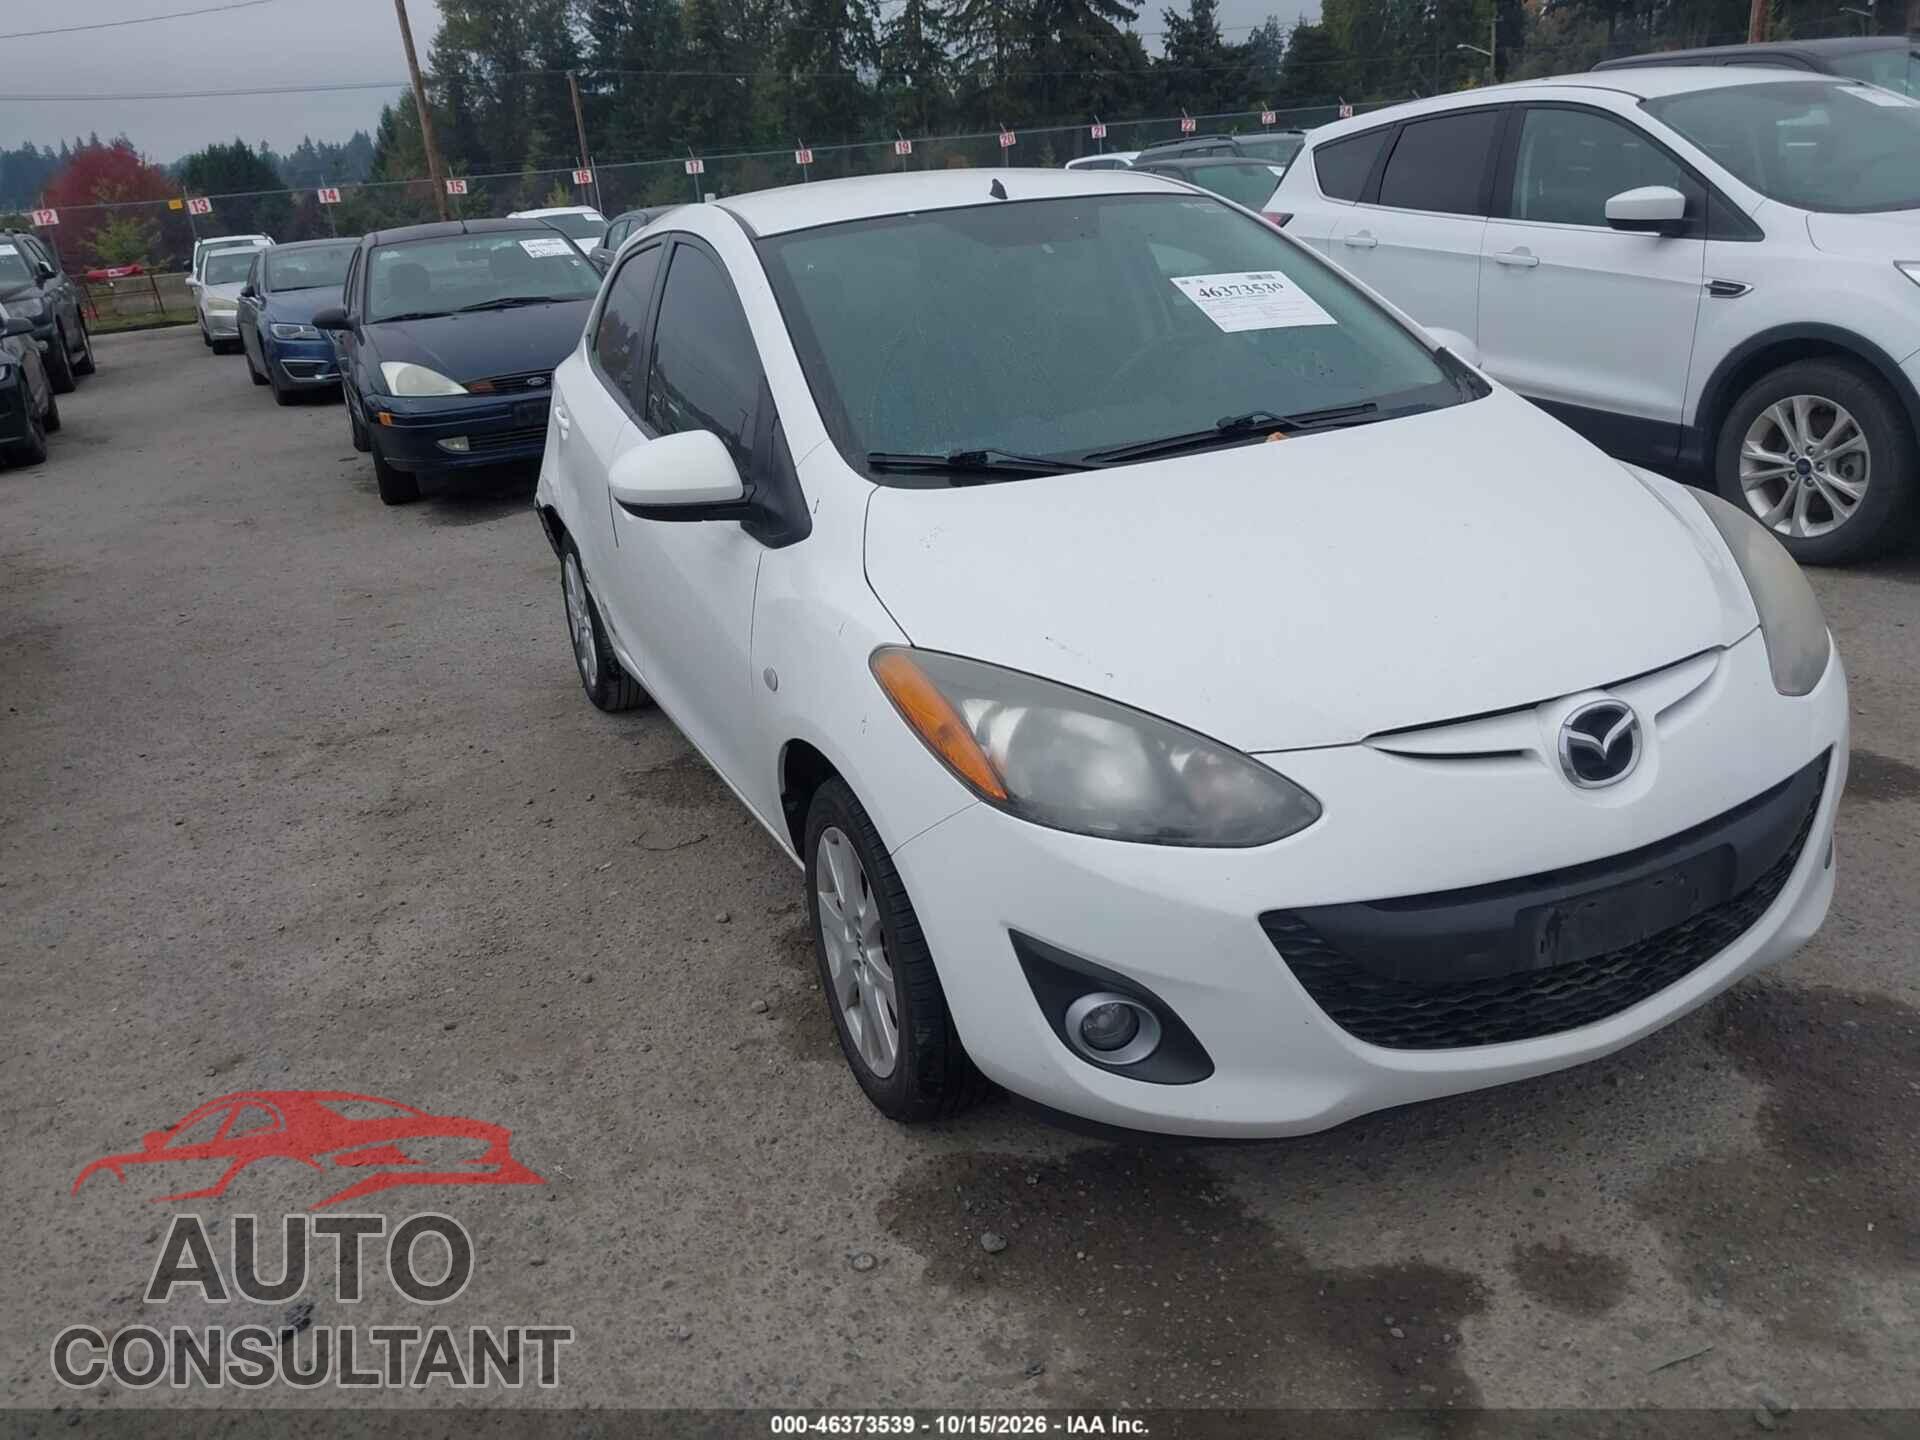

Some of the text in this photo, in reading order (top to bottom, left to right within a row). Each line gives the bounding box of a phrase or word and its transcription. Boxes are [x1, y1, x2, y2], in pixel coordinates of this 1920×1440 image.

[1094, 126, 1106, 138] 21
[898, 141, 910, 154] 19
[688, 160, 700, 173] 17
[576, 170, 590, 183] 16
[450, 181, 464, 193] 15
[321, 189, 337, 202] 14
[191, 199, 209, 213] 13
[36, 210, 55, 225] 12
